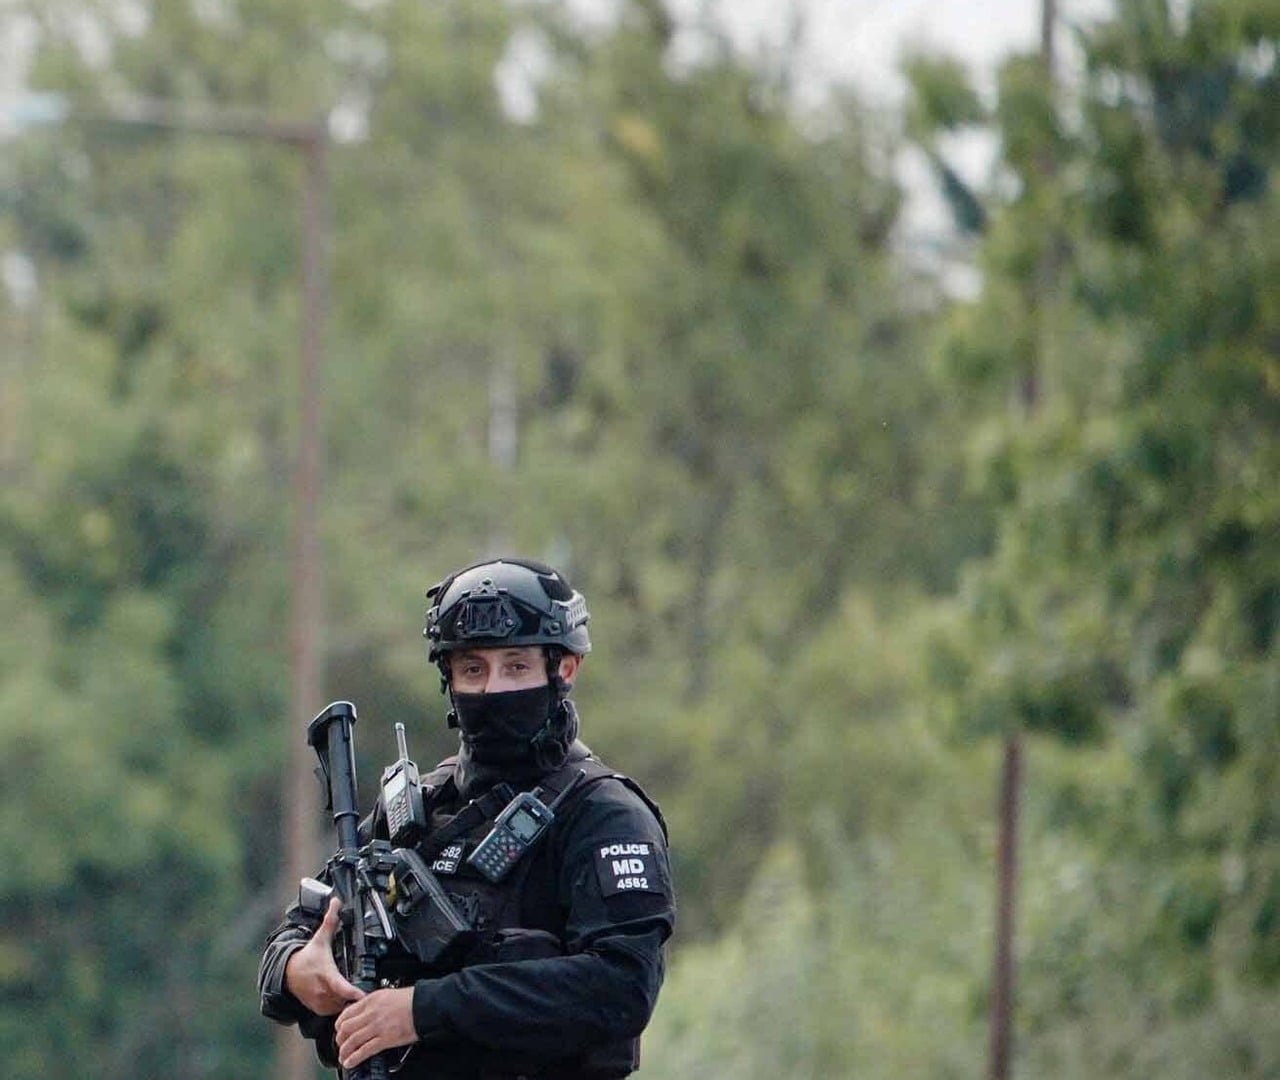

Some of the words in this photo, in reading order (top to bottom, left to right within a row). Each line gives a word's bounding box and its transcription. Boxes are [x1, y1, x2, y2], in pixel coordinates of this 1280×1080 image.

[600, 844, 649, 858] POLICE
[612, 858, 645, 876] MD
[617, 877, 648, 889] 4582
